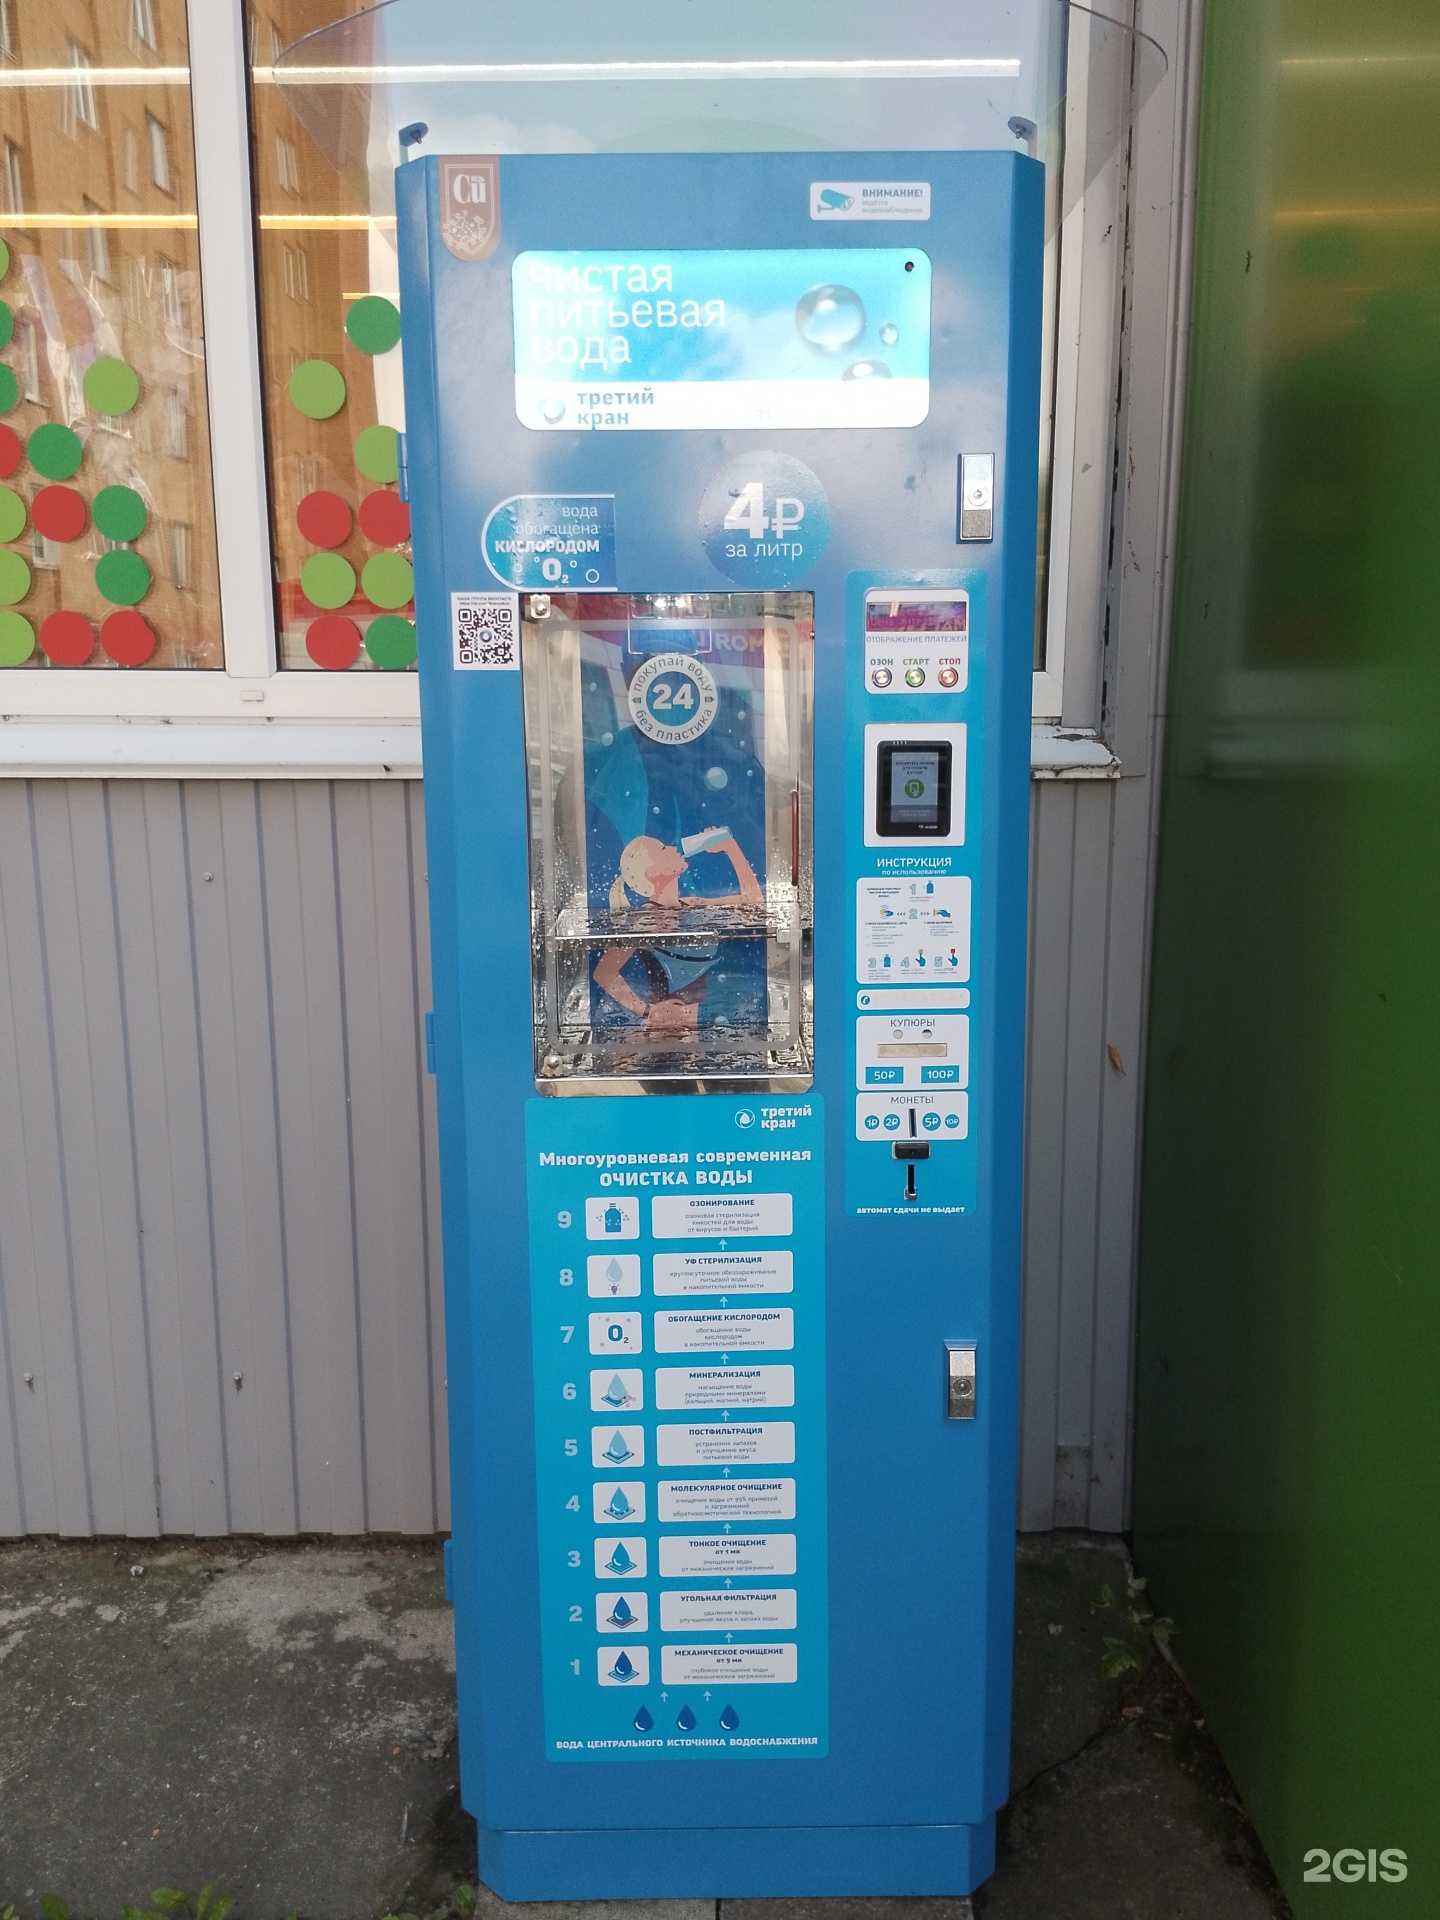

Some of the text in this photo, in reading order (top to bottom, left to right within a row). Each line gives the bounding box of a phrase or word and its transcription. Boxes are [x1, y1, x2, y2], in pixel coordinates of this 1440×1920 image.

[862, 188, 924, 198] ВНИМАНИЕ!
[577, 387, 654, 409] третий
[577, 411, 629, 429] кран
[562, 506, 598, 519] вода
[725, 543, 803, 562] за литр
[866, 635, 923, 644] ОТОБРАЖЕНИЕ
[870, 657, 961, 666] ОЗОН СТАРТ СТОП
[634, 655, 713, 692] покупай воду
[652, 683, 694, 709] 24
[636, 709, 712, 740] без пластика
[876, 857, 952, 868] ИНСТРУКЦИЯ
[890, 1019, 936, 1027] КУПЮРЫ
[890, 1096, 934, 1104] МОНЕТЫ
[761, 1104, 812, 1119] третий
[761, 1118, 796, 1131] кран
[539, 1150, 811, 1168] Многоуровневая современная
[600, 1169, 753, 1187] ОЧИСТКА ВОДЫ
[689, 1199, 755, 1207] ОЗОНИРОВАНИЕ
[893, 1207, 919, 1215] сдачи
[932, 1206, 965, 1214] выдает
[557, 1211, 572, 1229] 9
[698, 1257, 762, 1265] СТЕРИЛИЗАЦИЯ
[559, 1268, 574, 1287] 8
[668, 1313, 781, 1323] ОБОГАЩЕНИЕ КИСЛОРОДОМ
[559, 1325, 575, 1344] 7
[689, 1371, 761, 1379] МИНЕРАЛИЗАЦИЯ
[562, 1382, 577, 1400] 6
[689, 1427, 763, 1436] ПОСТФИЛЬТРАЦИЯ
[564, 1439, 578, 1457] 5
[671, 1483, 783, 1492] МОЛЕКУЛЯРНОЕ ОЧИЩЕНИЕ
[565, 1495, 580, 1512] 4
[689, 1539, 767, 1548] ТОНКОЕ ОЧИЩЕНИЕ
[567, 1550, 581, 1567] 3
[723, 1593, 777, 1602] ФИЛЬТРАЦИЯ
[569, 1605, 583, 1622] 2
[674, 1648, 784, 1657] МЕХАНИЧЕСКОЕ ОЧИЩЕНИЕ
[570, 1659, 580, 1676] 1
[556, 1736, 818, 1750] ВОДА ЦЕНТРАЛЬНОГО ИСТОЧНИКА ВОДОСНАБЖЕНИЯ
